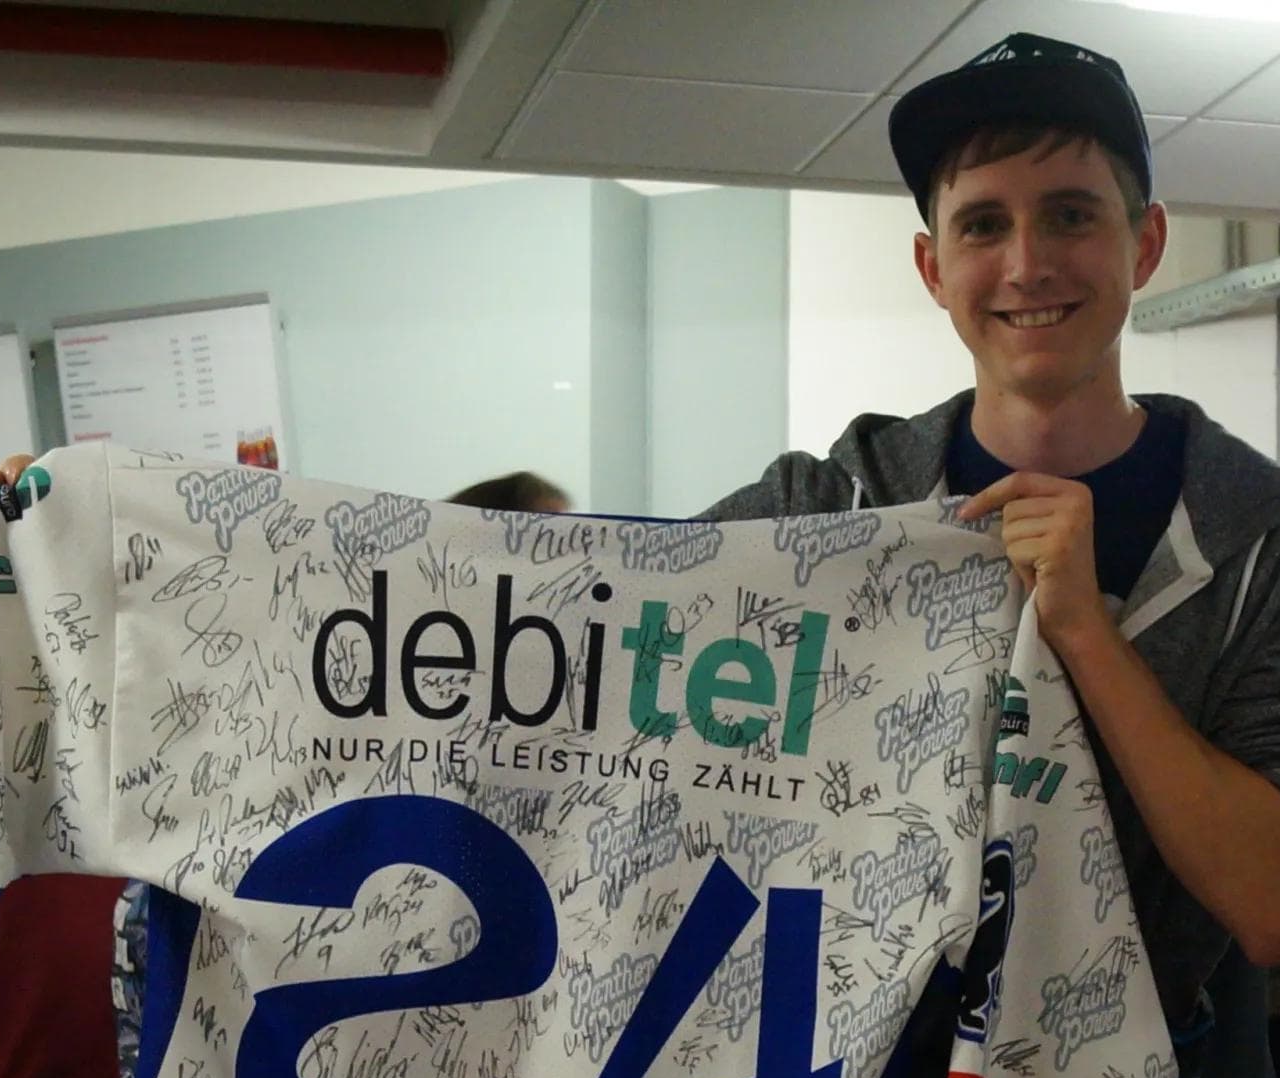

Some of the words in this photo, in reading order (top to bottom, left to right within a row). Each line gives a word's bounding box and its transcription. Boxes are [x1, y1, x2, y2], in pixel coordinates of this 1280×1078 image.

[907, 554, 1011, 617] Panther
[312, 570, 830, 757] debitel
[312, 737, 385, 763] NUR
[410, 738, 467, 763] DIE
[491, 743, 670, 783] LEISTUNG
[692, 763, 806, 801] ZÄHLT
